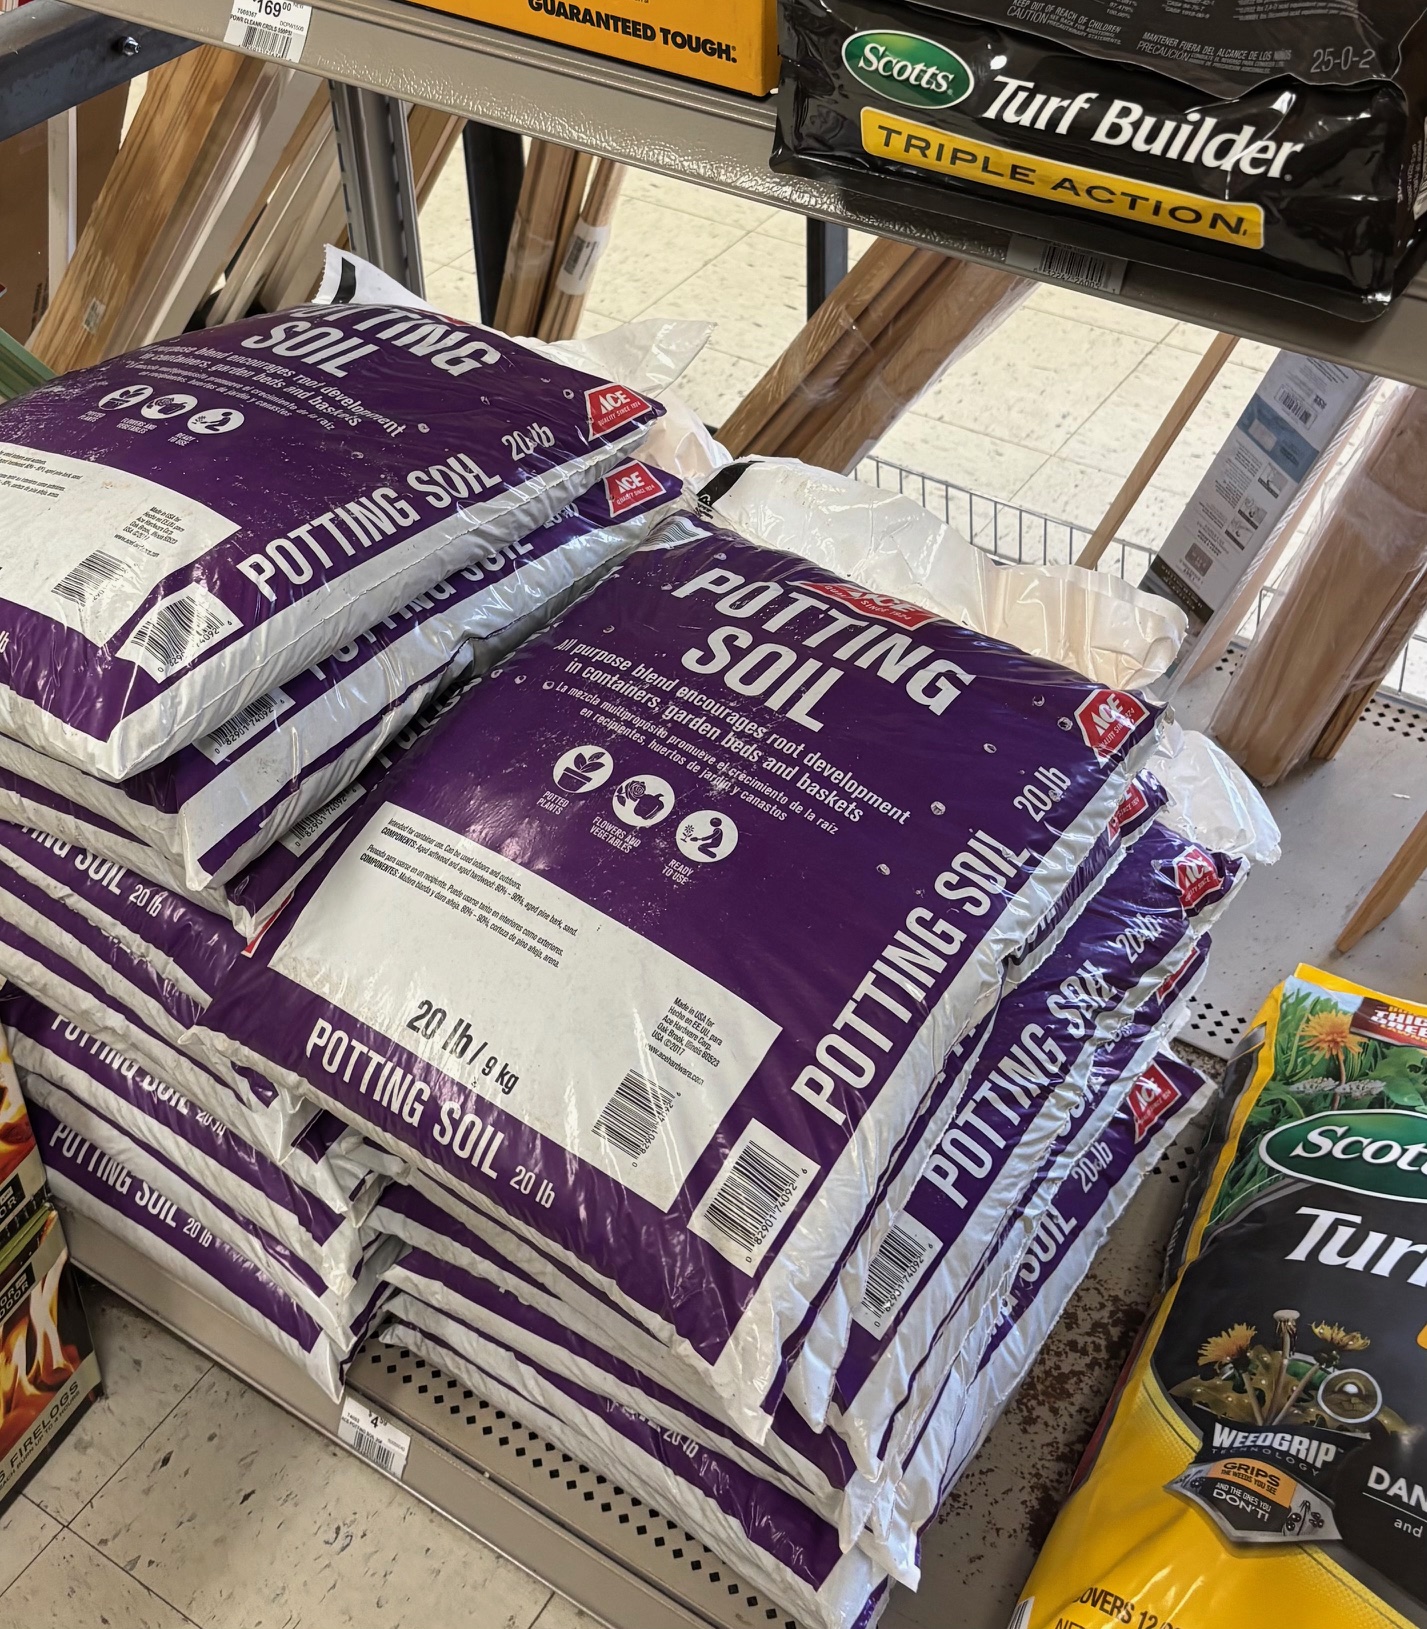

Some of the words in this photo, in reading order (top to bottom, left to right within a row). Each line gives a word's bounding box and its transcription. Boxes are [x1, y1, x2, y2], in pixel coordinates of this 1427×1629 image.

[253, 0, 281, 17] 169
[1006, 6, 1049, 24] CAUTION
[1030, 1, 1044, 11] OUT
[1055, 7, 1077, 20] REACH
[1088, 19, 1122, 33] CHILDREN
[528, 0, 656, 41] GUARANTEED
[660, 27, 738, 63] TOUGH.
[1141, 32, 1178, 47] MANTENER
[1179, 41, 1200, 53] FUERA
[1201, 45, 1216, 56] DEL
[1217, 48, 1246, 60] ALCANCE
[1247, 49, 1258, 60] DE
[1136, 41, 1192, 62] PRECAUCIÓN
[1310, 46, 1376, 74] 25-0-2
[857, 41, 956, 97] Scotts
[982, 76, 1089, 131] Turf
[1091, 98, 1304, 181] Builder
[876, 124, 1035, 184] TRIPLE
[1051, 176, 1245, 237] ACTION
[241, 320, 380, 378] SOIL
[293, 373, 327, 389] root
[320, 381, 407, 438] development
[308, 396, 362, 427] baskets
[599, 390, 631, 415] ACE
[501, 430, 535, 461] 20
[615, 471, 645, 494] ACE
[236, 487, 421, 602] POTTING
[406, 453, 502, 508] SOIL
[671, 567, 977, 716] POTTING
[681, 625, 844, 732] SOIL
[226, 725, 250, 746] 82901
[249, 707, 274, 726] 74092
[1091, 693, 1124, 737] ACE
[553, 638, 578, 652] All
[570, 642, 633, 672] purpose
[631, 663, 680, 693] blend
[676, 685, 768, 740] encourages
[766, 733, 805, 760] root
[803, 751, 911, 826] development
[564, 657, 583, 674] in
[581, 666, 661, 714] containers,
[661, 704, 722, 741] garden
[720, 731, 763, 763] beds
[762, 756, 800, 782] and
[795, 772, 864, 824] baskets
[555, 681, 569, 693] La
[567, 686, 601, 707] mezcla
[666, 734, 717, 765] promueve
[728, 767, 789, 806] crecimiento
[788, 799, 805, 814] de
[803, 808, 816, 822] la
[816, 817, 840, 835] raíz
[579, 707, 593, 718] en
[592, 711, 646, 746] recipientes,
[647, 738, 687, 766] huertos
[686, 760, 702, 773] de
[698, 767, 732, 790] jardín
[740, 789, 788, 822] canastos
[536, 797, 564, 816] PLANTS
[542, 790, 570, 809] POTTED
[1013, 784, 1053, 823] 20
[1033, 766, 1072, 797] lb
[304, 815, 327, 838] 82901
[380, 826, 418, 849] COMPONENTS:
[388, 817, 409, 833] Intended
[413, 831, 436, 845] container
[443, 844, 455, 855] Can
[459, 853, 474, 865] used
[589, 825, 634, 854] VEGETABLES
[592, 816, 627, 840] FLOWERS
[625, 833, 642, 848] AND
[359, 852, 400, 878] COMPONENTES:
[661, 865, 673, 876] TO
[671, 870, 688, 886] USE
[668, 858, 694, 877] READY
[128, 884, 150, 907] 20
[498, 913, 523, 932] interiores
[521, 928, 538, 941] como
[1115, 927, 1145, 964] 20
[791, 907, 968, 1126] POTTING
[934, 830, 1031, 917] SOIL
[662, 1014, 675, 1026] Ace
[672, 1020, 699, 1041] Hardware
[668, 1005, 686, 1021] Hecho
[684, 1016, 693, 1026] en
[708, 1034, 723, 1047] para
[673, 996, 690, 1012] Made
[688, 1006, 695, 1016] in
[694, 1010, 708, 1024] USA
[705, 1017, 716, 1028] for
[651, 1029, 664, 1043] USA
[656, 1022, 670, 1035] Oak
[406, 999, 448, 1040] 20
[441, 1017, 474, 1060] lb
[481, 1055, 498, 1077] 9
[494, 1062, 520, 1096] kg
[305, 1017, 431, 1128] POTTING
[432, 1101, 505, 1180] SOIL
[509, 1165, 536, 1195] 20
[535, 1178, 556, 1210] lb
[922, 1022, 1066, 1210] POTTING
[1071, 1156, 1098, 1194] 20
[1090, 1141, 1114, 1170] lb
[753, 1212, 776, 1246] 82901
[773, 1182, 799, 1215] 74092
[182, 1217, 201, 1238] 20
[199, 1229, 214, 1248] lb
[898, 1254, 926, 1287] 74092
[9, 1381, 79, 1469] FIRELOGS
[16, 1446, 34, 1470] BURN
[34, 1434, 44, 1447] UP
[44, 1423, 54, 1435] TO
[1212, 1421, 1337, 1469] WEEDGRIP
[1211, 1446, 1320, 1477] TECHNOLOGY
[1223, 1462, 1281, 1488] GRIPS
[1232, 1471, 1253, 1484] WEEDS
[1212, 1488, 1270, 1522] DON'T!
[1215, 1482, 1229, 1492] AND
[1229, 1486, 1243, 1497] THE
[1242, 1491, 1259, 1506] ONES
[1259, 1499, 1272, 1513] YOU
[1393, 1517, 1424, 1539] and
